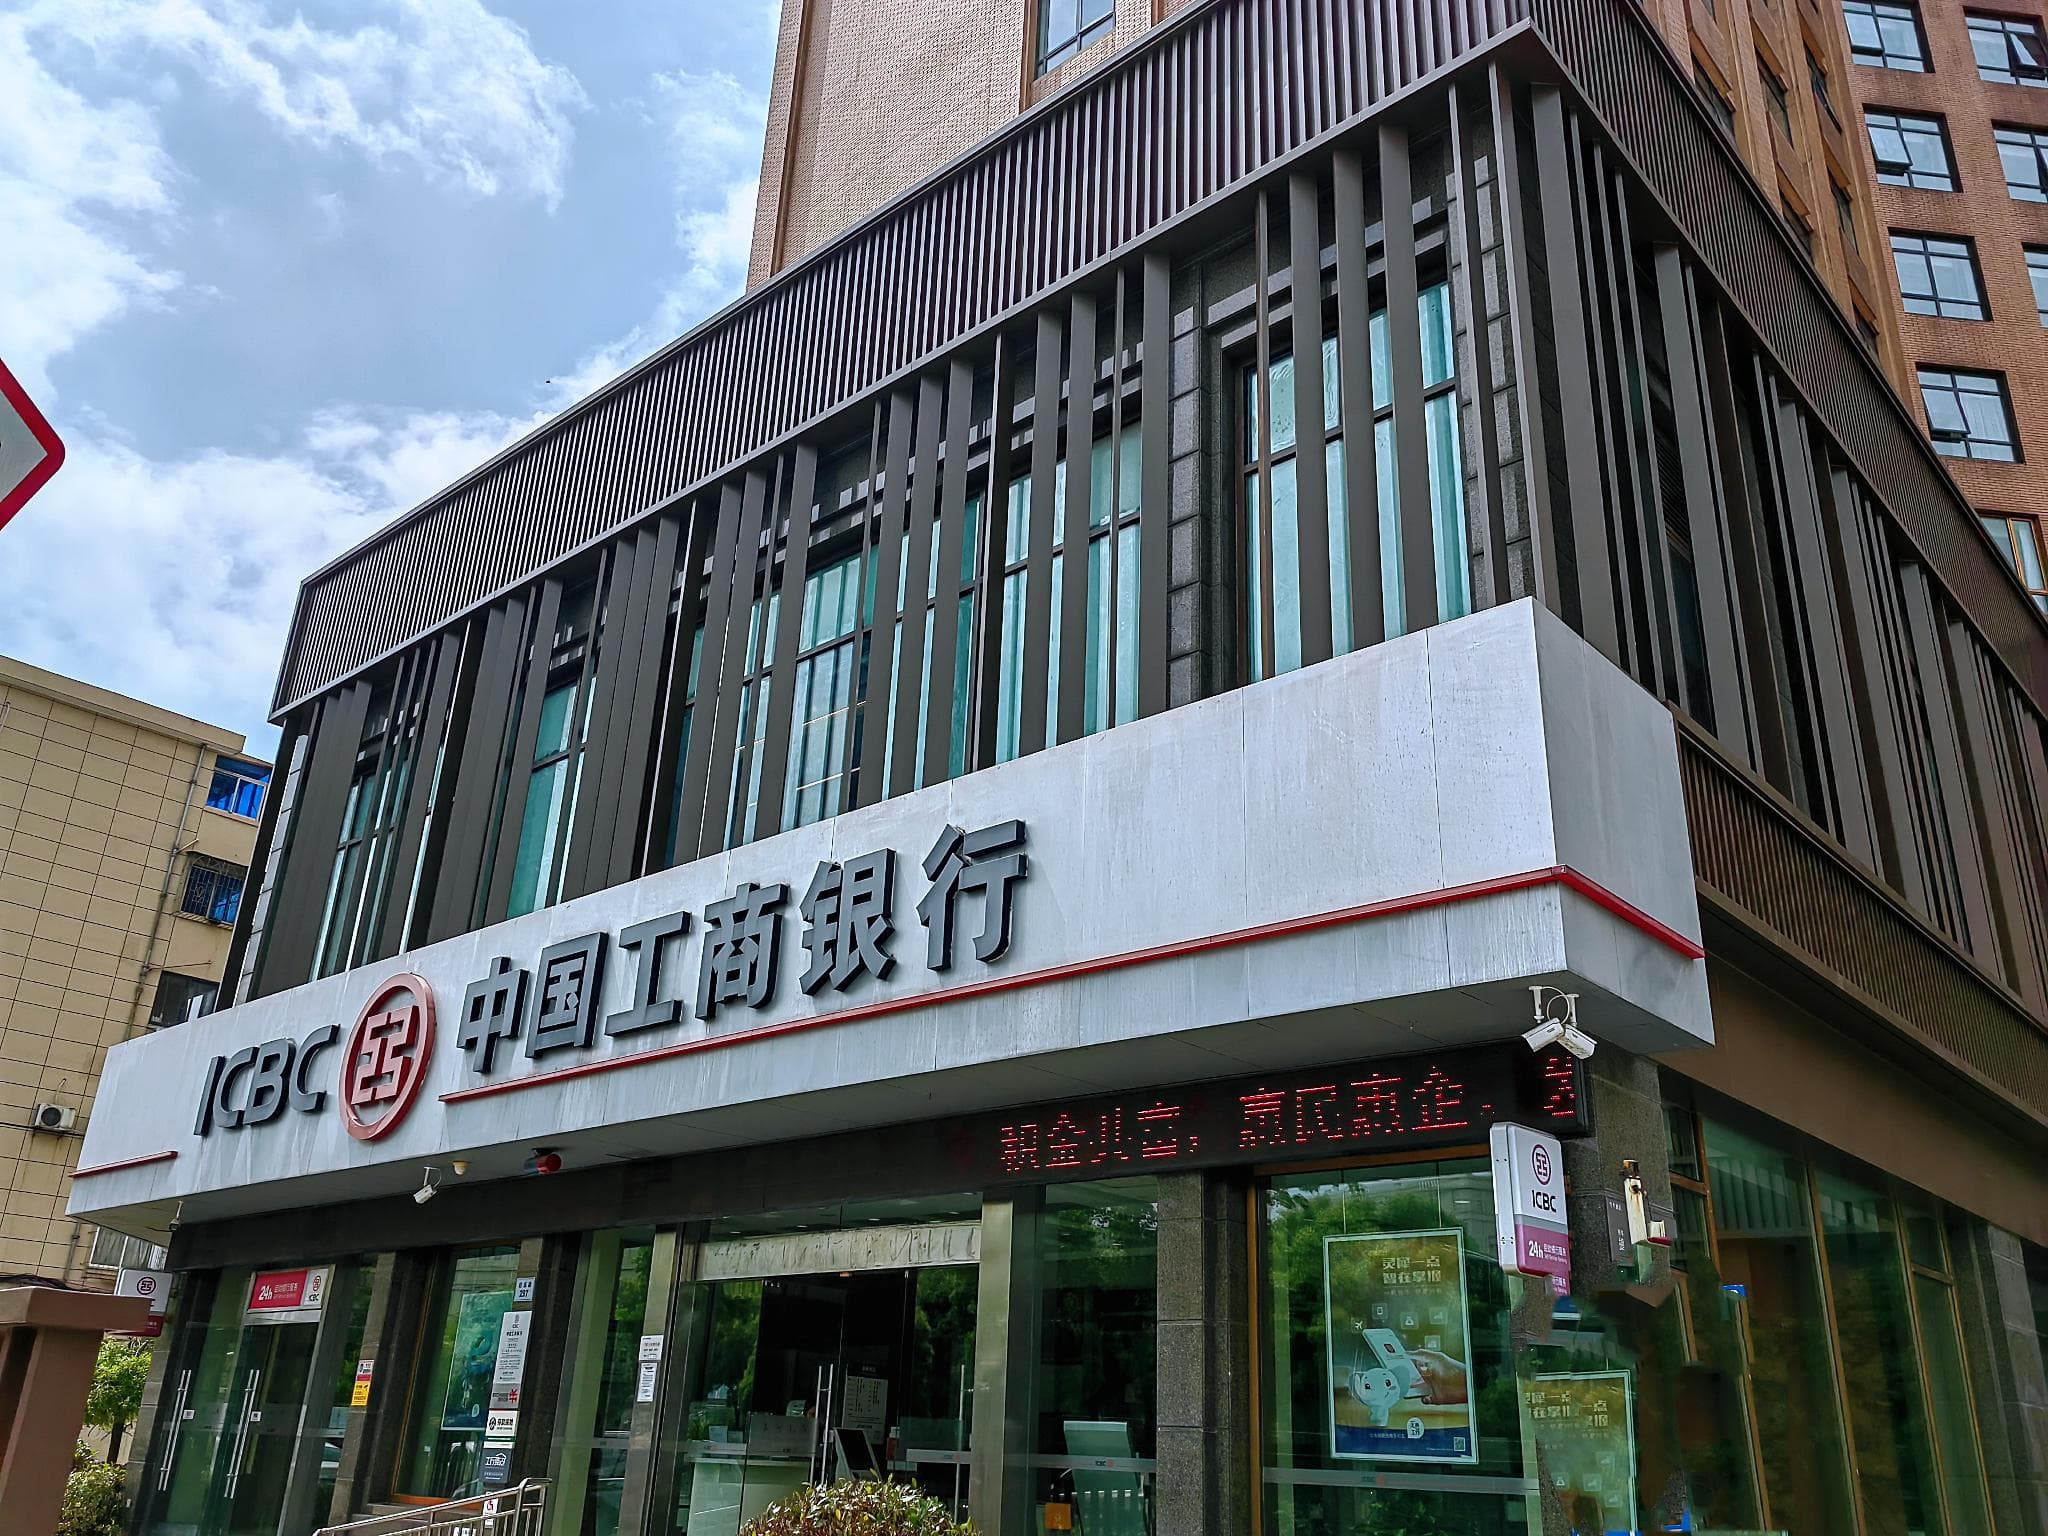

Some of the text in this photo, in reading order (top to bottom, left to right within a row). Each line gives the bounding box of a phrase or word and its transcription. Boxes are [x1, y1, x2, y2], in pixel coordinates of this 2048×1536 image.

[457, 820, 1028, 1073] 中国工商银行
[194, 1024, 340, 1136] ICBC
[1531, 1190, 1557, 1213] ICBC
[1529, 1240, 1544, 1259] 24h
